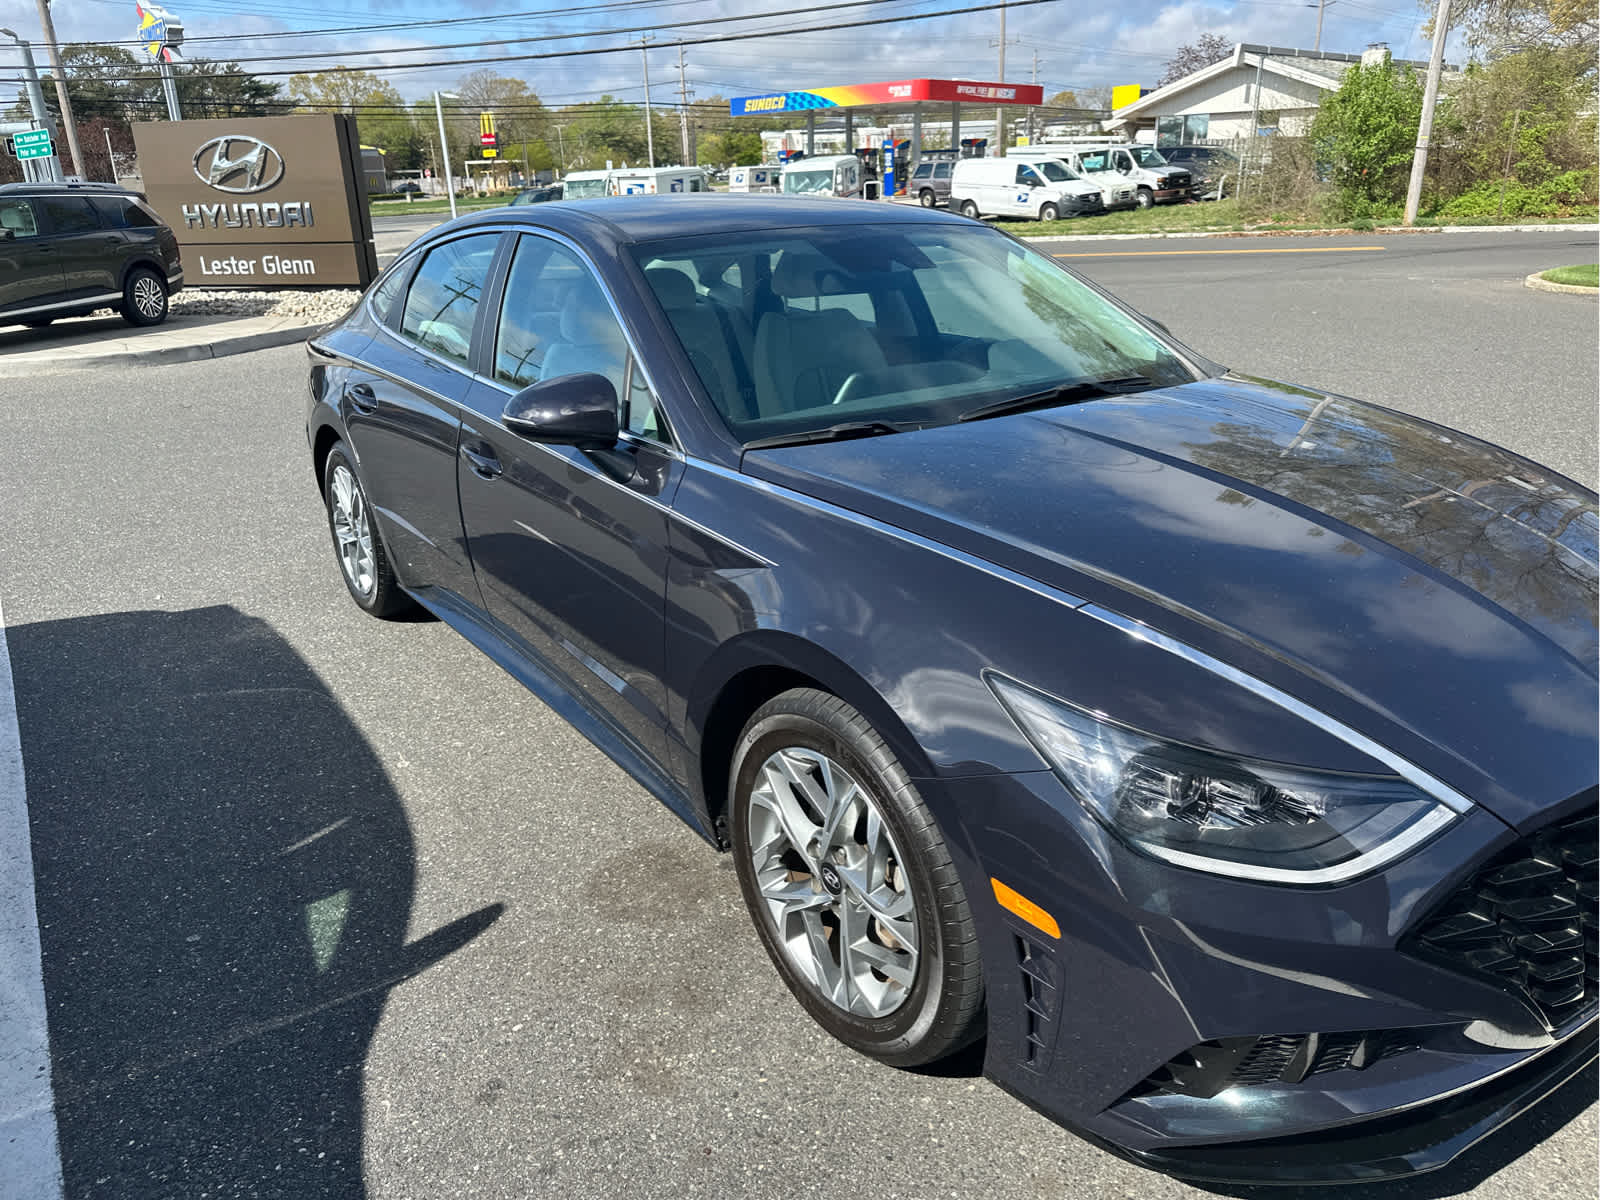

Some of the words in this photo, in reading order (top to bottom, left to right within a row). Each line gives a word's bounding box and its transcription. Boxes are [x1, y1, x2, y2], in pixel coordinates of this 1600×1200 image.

[744, 96, 786, 112] SUNOCO
[182, 201, 314, 228] HYUNDAI
[200, 256, 257, 275] Lester
[262, 255, 316, 275] Glenn
